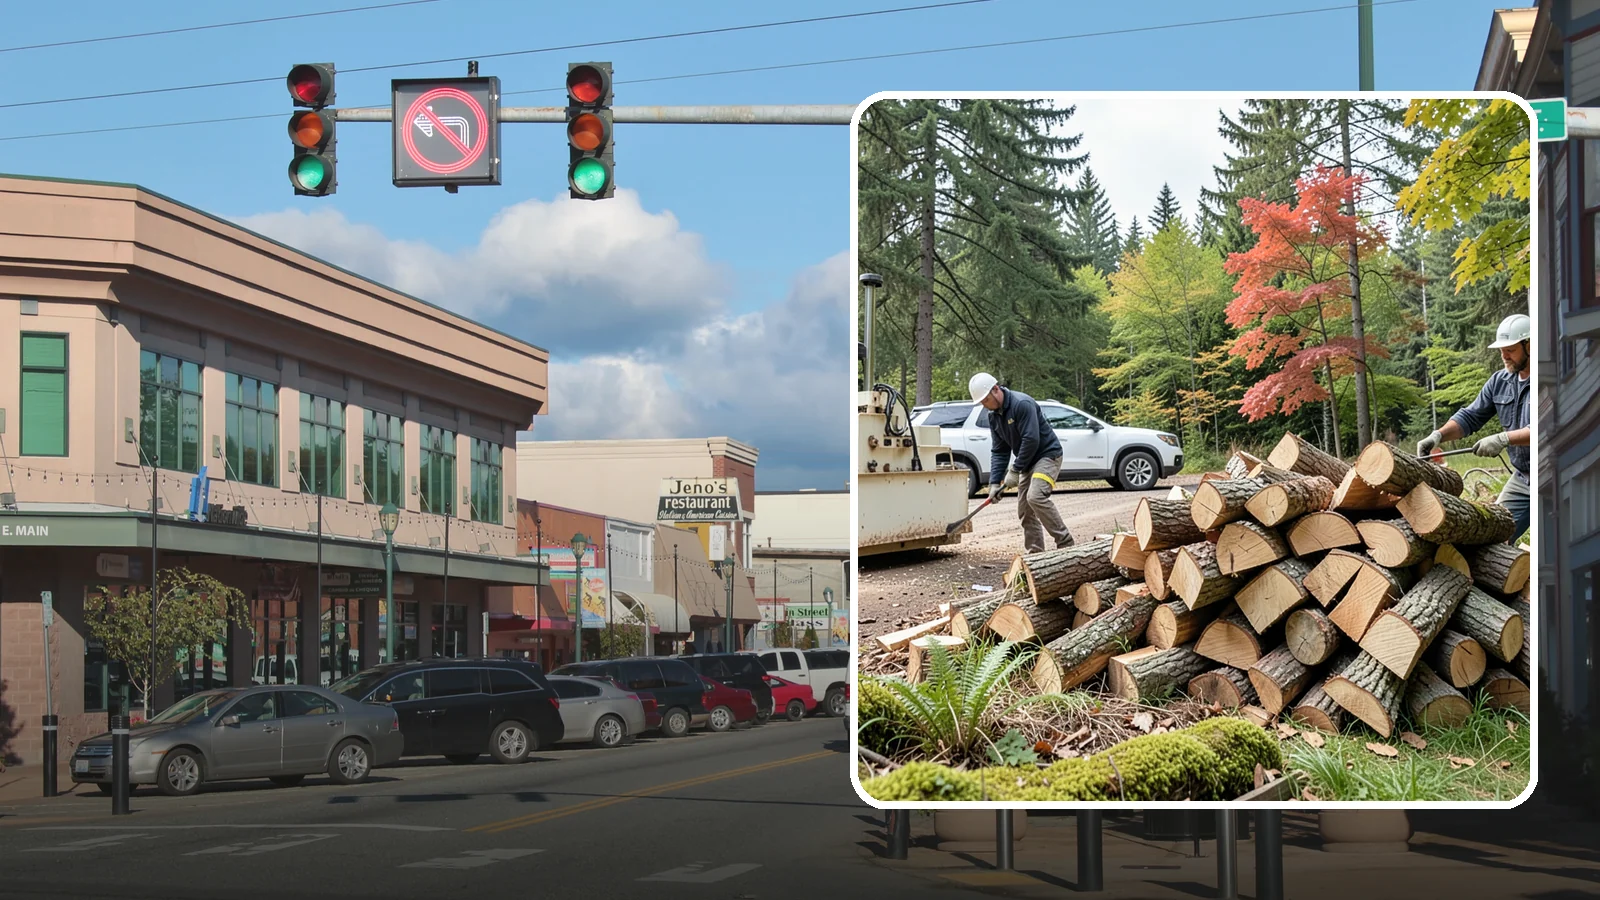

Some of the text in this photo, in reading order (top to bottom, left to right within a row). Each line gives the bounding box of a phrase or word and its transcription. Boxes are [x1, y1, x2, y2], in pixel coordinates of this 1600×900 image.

[670, 480, 727, 494] Jeno's
[665, 496, 731, 508] restaurant
[658, 510, 681, 520] Italian
[686, 510, 714, 519] American
[715, 510, 737, 519] Cuisine
[2, 525, 48, 536] E. MAIN
[797, 607, 828, 616] Street
